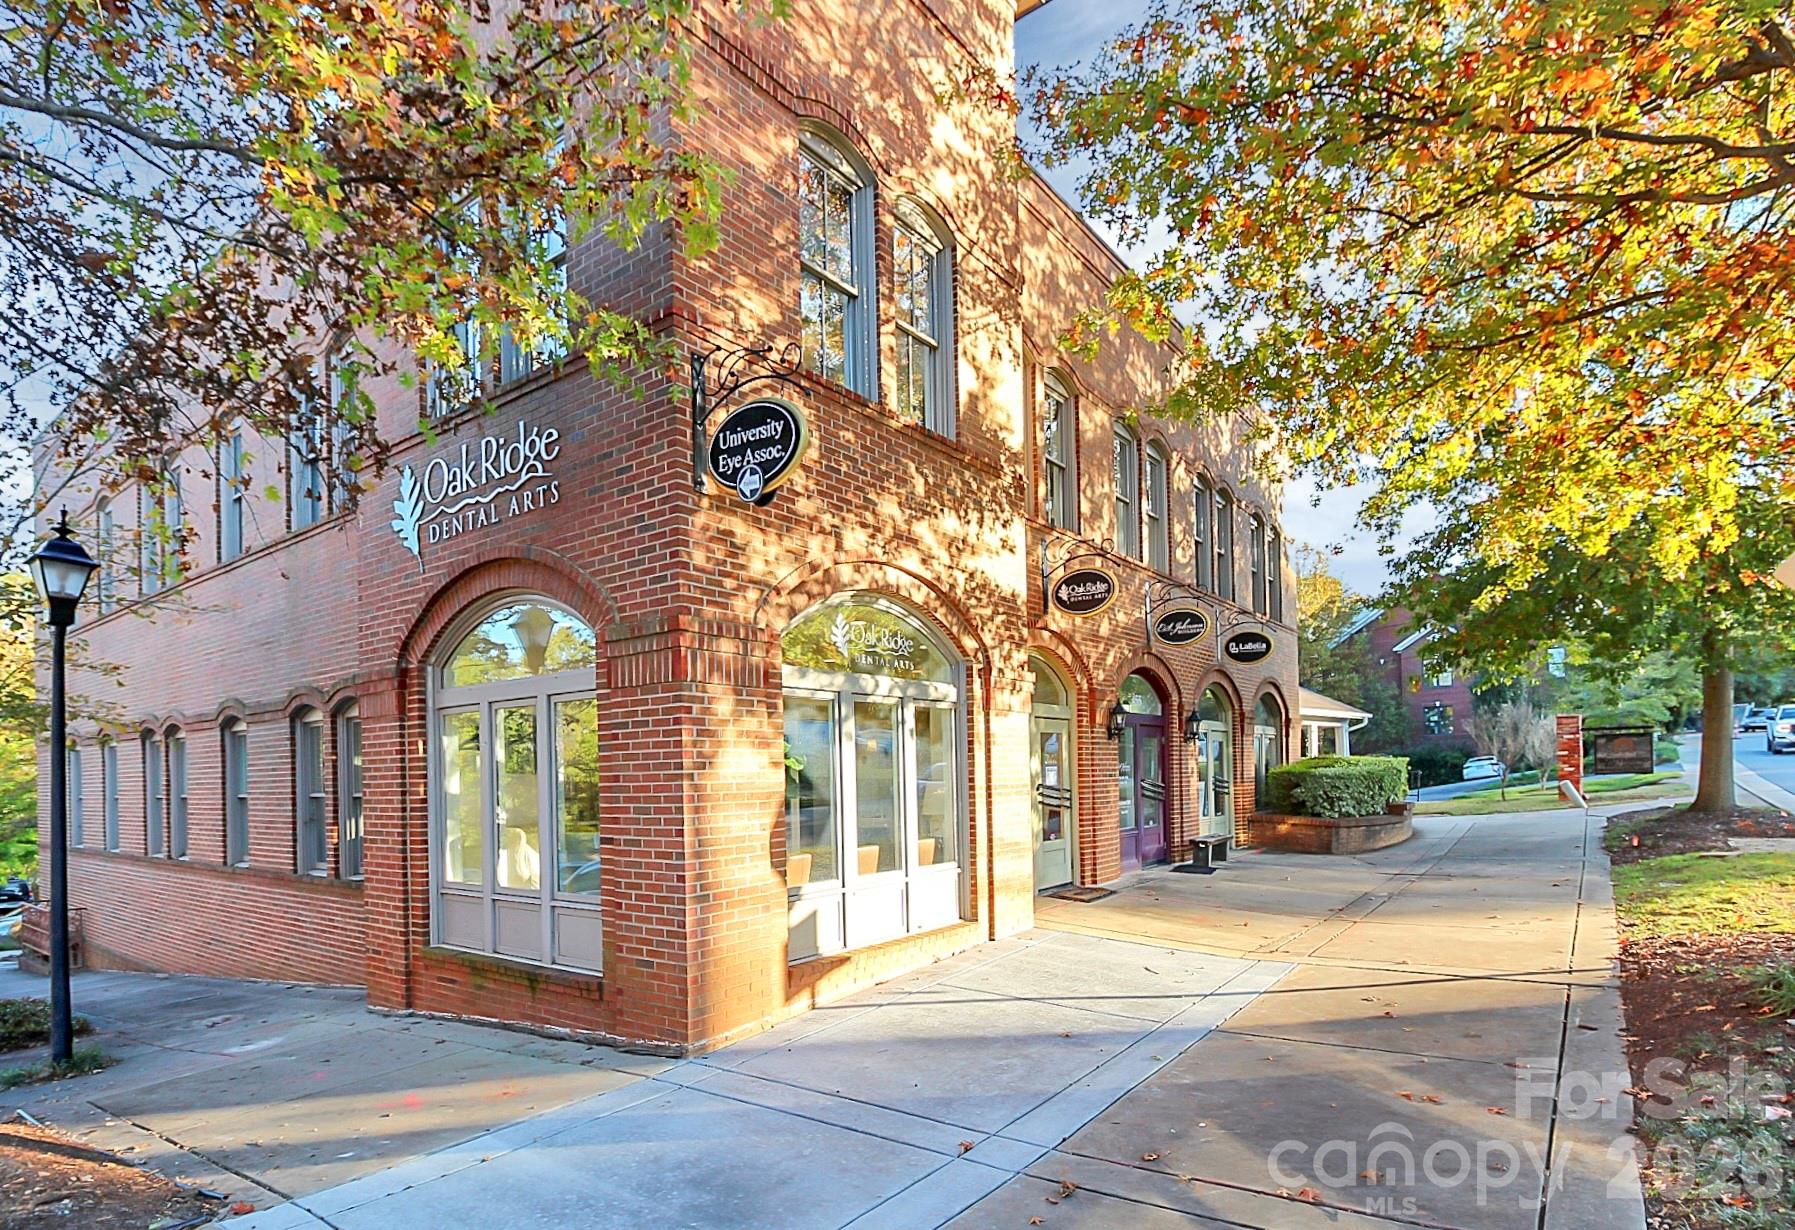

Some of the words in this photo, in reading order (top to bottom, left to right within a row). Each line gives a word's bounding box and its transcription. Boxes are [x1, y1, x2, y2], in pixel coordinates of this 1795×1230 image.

[719, 419, 785, 450] University
[424, 443, 477, 504] Oak
[481, 420, 560, 485] Ridge
[718, 454, 742, 475] Eye
[743, 444, 786, 466] Assoc.
[429, 503, 499, 544] DENTAL
[508, 480, 560, 517] ARTS
[1069, 583, 1086, 593] Oak
[1086, 581, 1109, 592] Ridge
[851, 623, 879, 646] Oak
[881, 628, 914, 653] Ridge
[855, 654, 891, 667] DENTAL
[894, 660, 915, 671] ARTS
